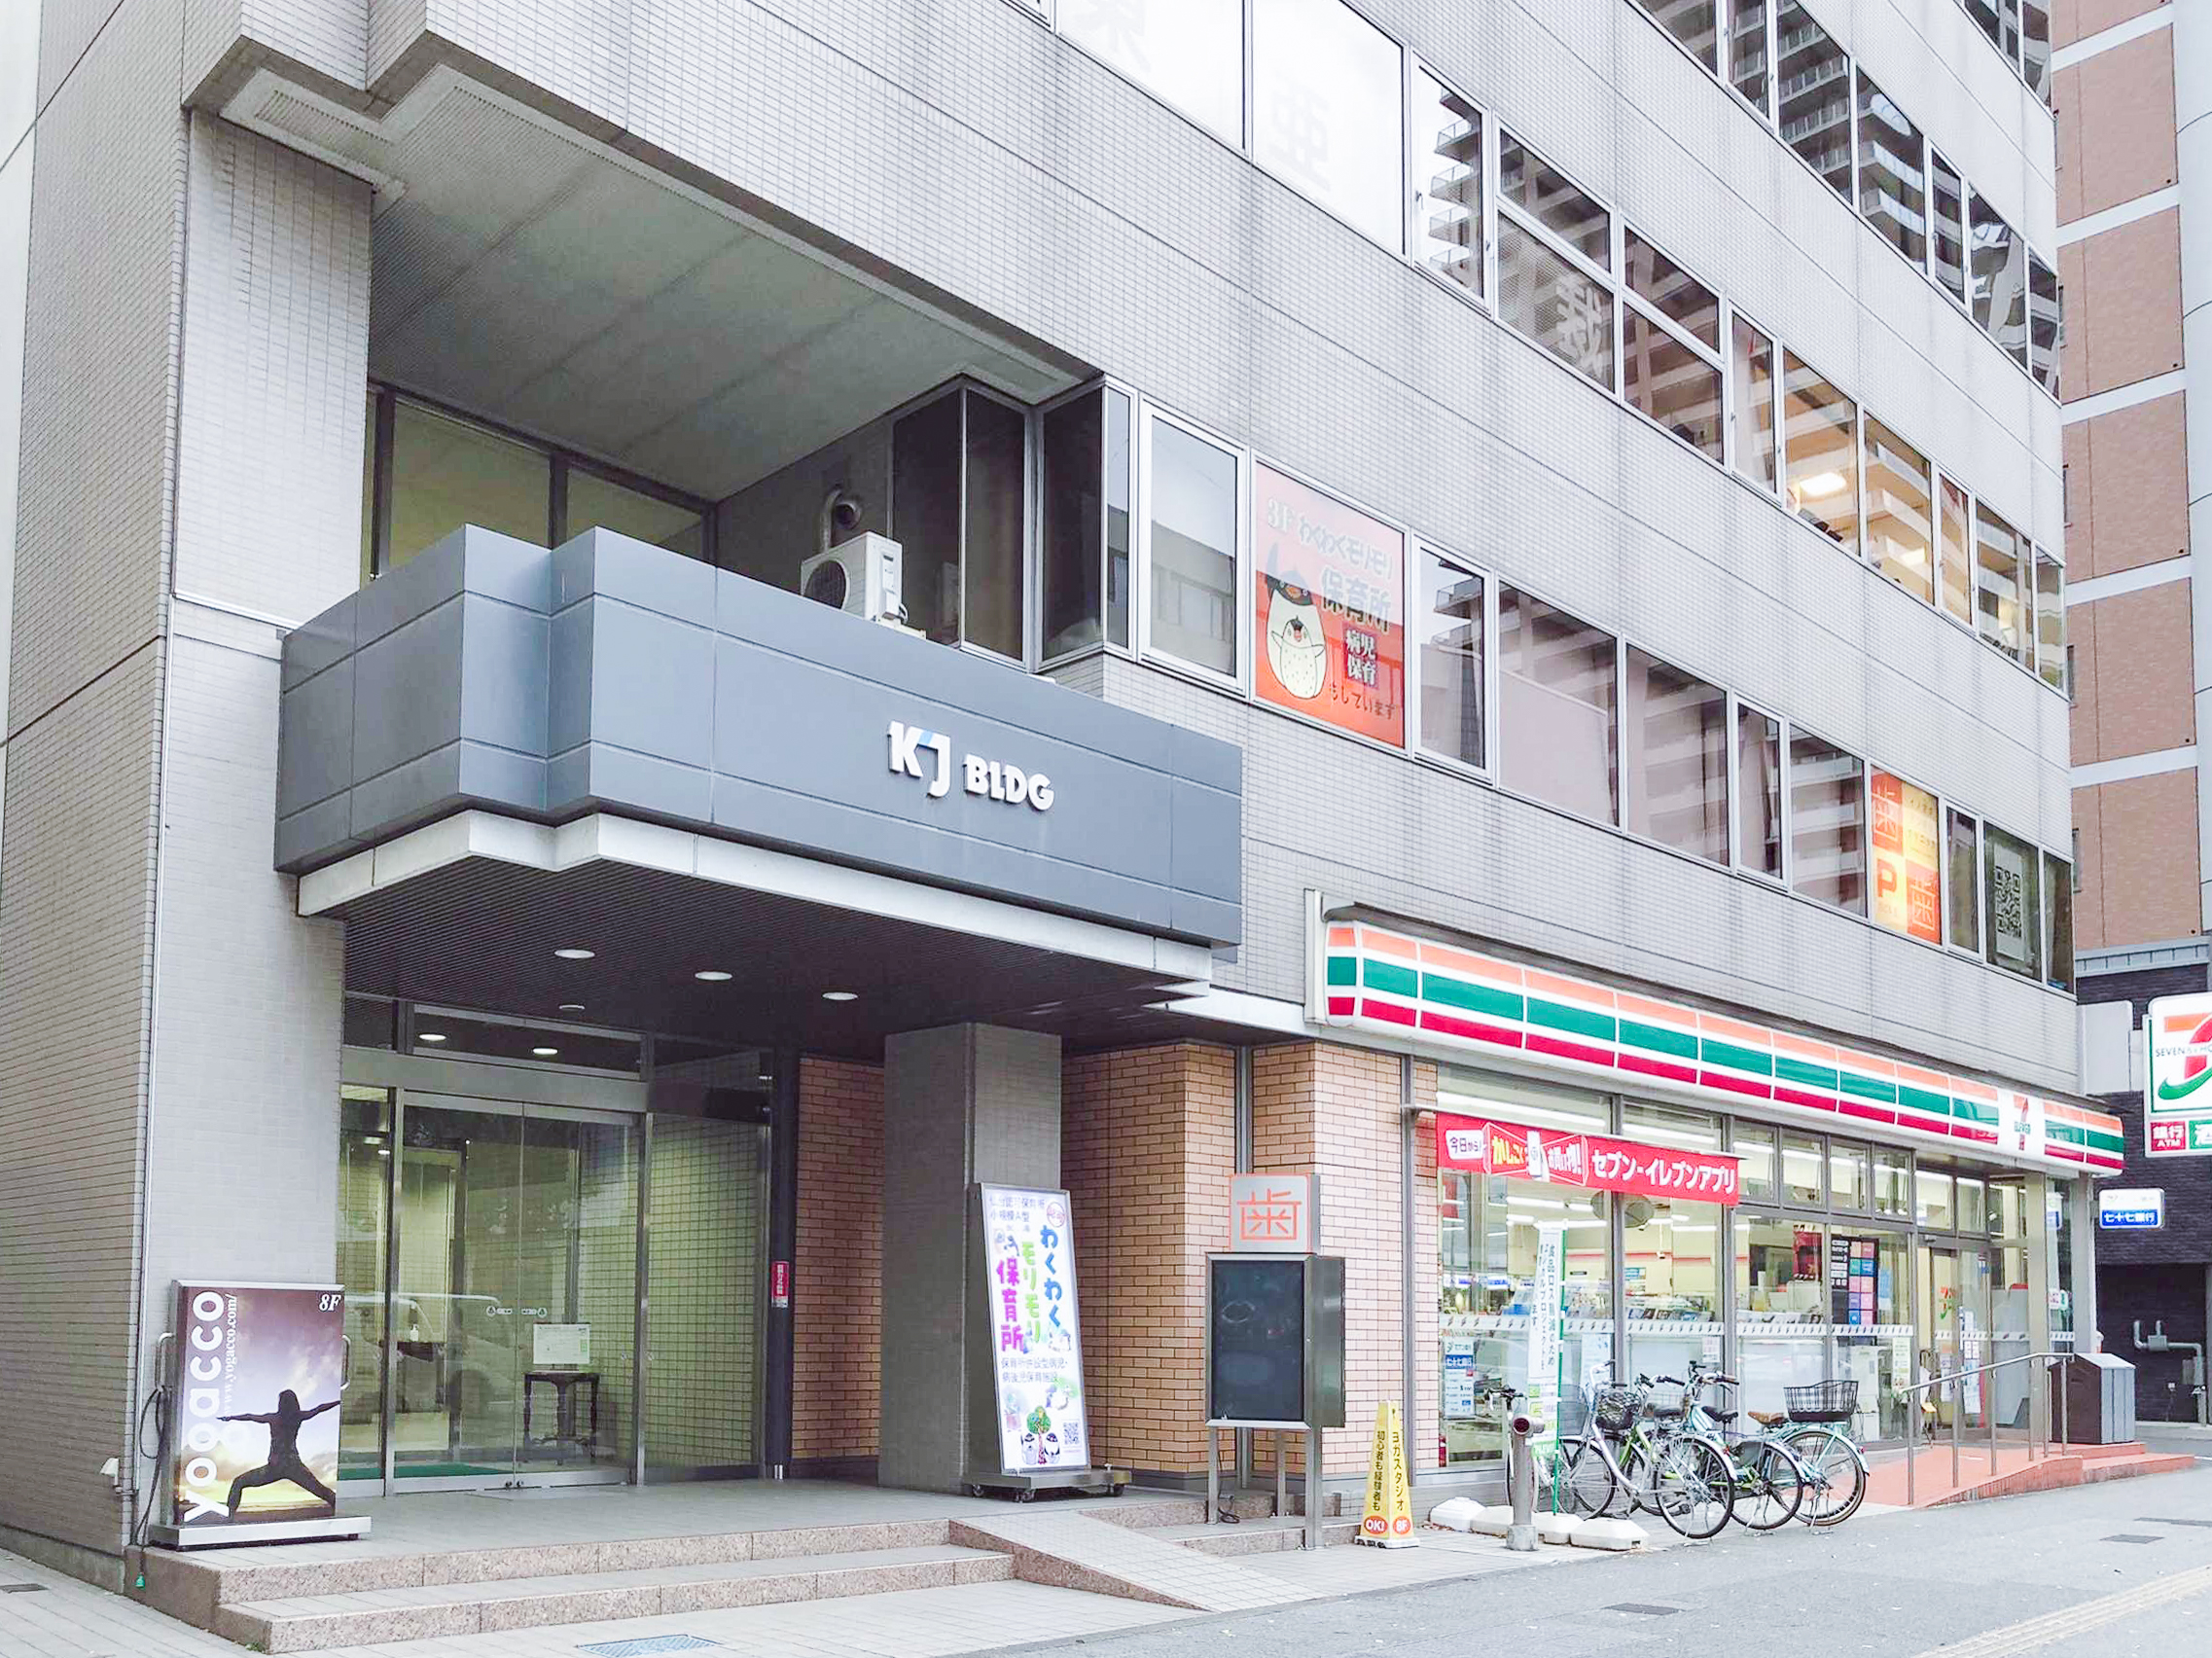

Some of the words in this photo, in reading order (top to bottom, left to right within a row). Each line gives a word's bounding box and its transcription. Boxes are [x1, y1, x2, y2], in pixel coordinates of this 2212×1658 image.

[1322, 565, 1391, 633] 保育所
[887, 720, 951, 798] KJ
[962, 753, 1055, 811] BLDG
[2156, 1138, 2182, 1147] ATM
[1235, 1187, 1302, 1241] 歯
[318, 1293, 342, 1312] 8F
[996, 1256, 1024, 1352] 保育所
[1021, 1242, 1042, 1345] モリモリ
[1040, 1225, 1063, 1327] わくわく
[183, 1291, 230, 1523] yogacco
[1392, 1431, 1405, 1511] ヨガスタジオ
[1365, 1519, 1385, 1532] OK!
